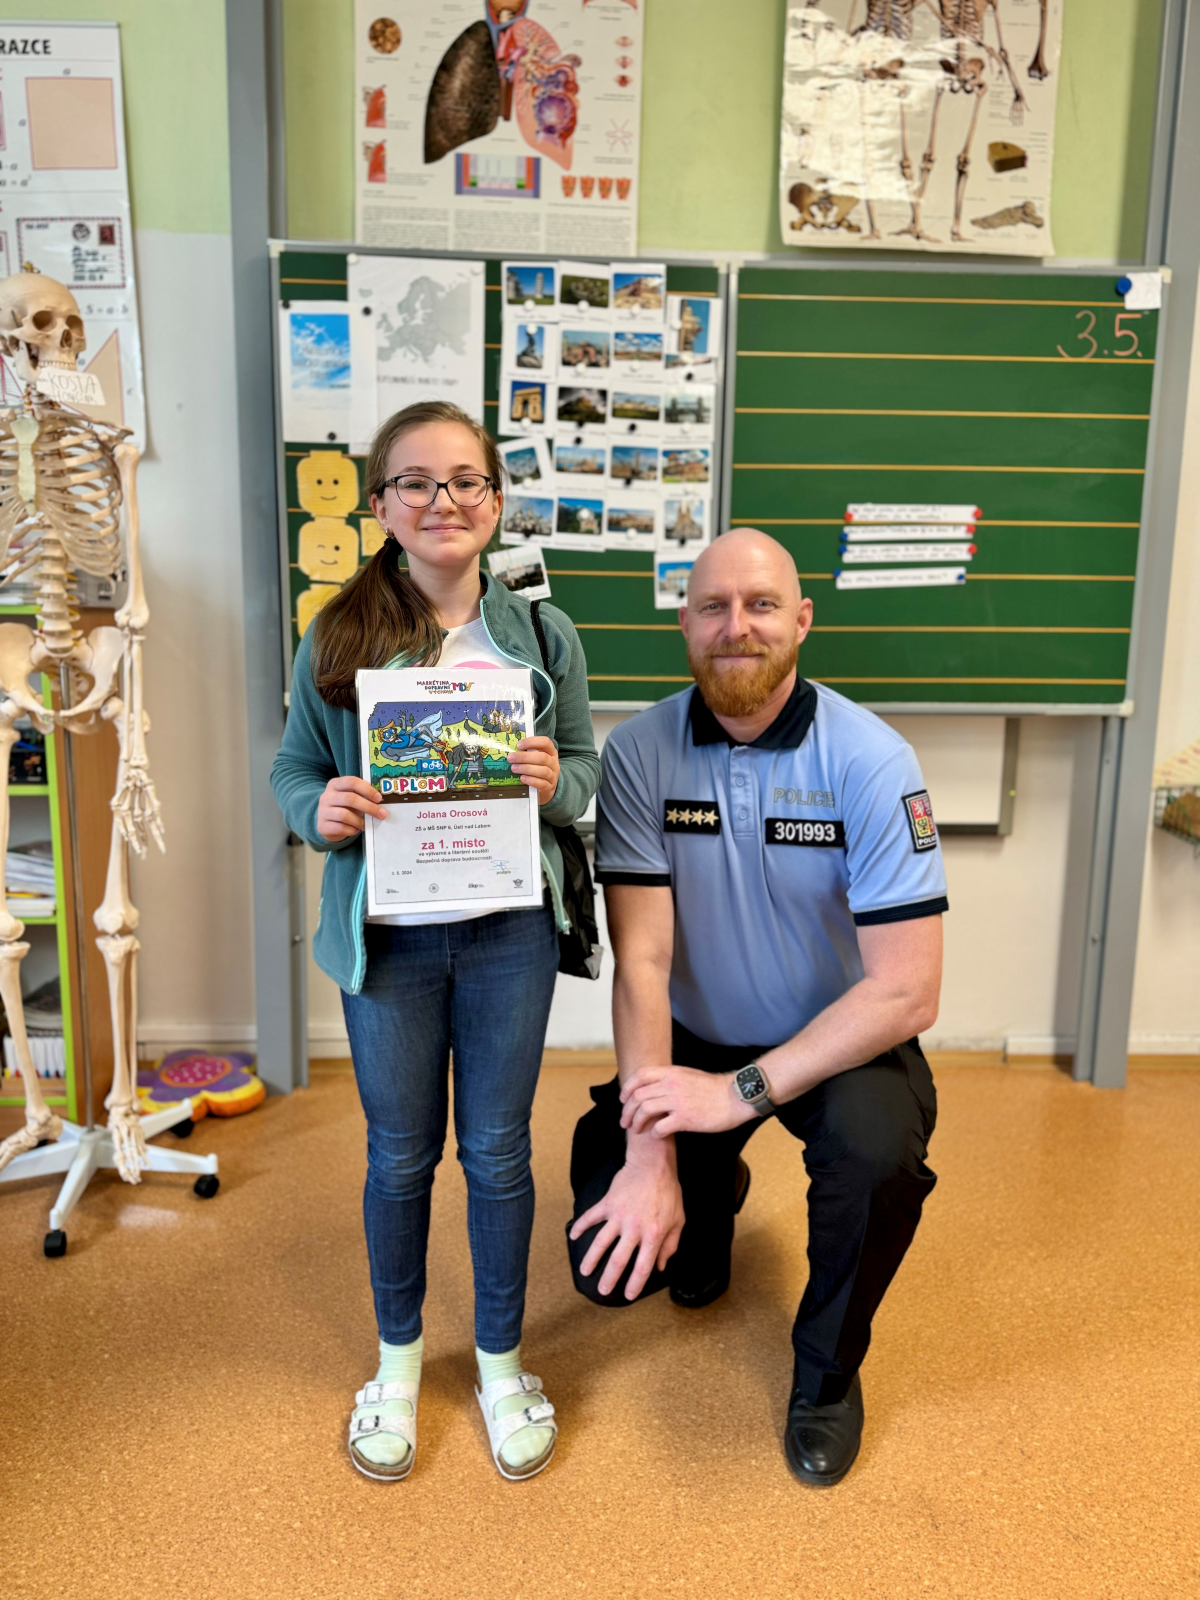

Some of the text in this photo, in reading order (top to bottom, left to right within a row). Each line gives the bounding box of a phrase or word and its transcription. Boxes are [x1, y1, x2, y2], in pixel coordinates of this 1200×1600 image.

[0, 39, 52, 55] RAZCE
[382, 777, 445, 792] DIPLOM
[773, 787, 835, 808] POLICE
[416, 808, 488, 819] Jolana Orosová
[774, 821, 836, 842] 301993
[421, 838, 486, 850] za 1. místo
